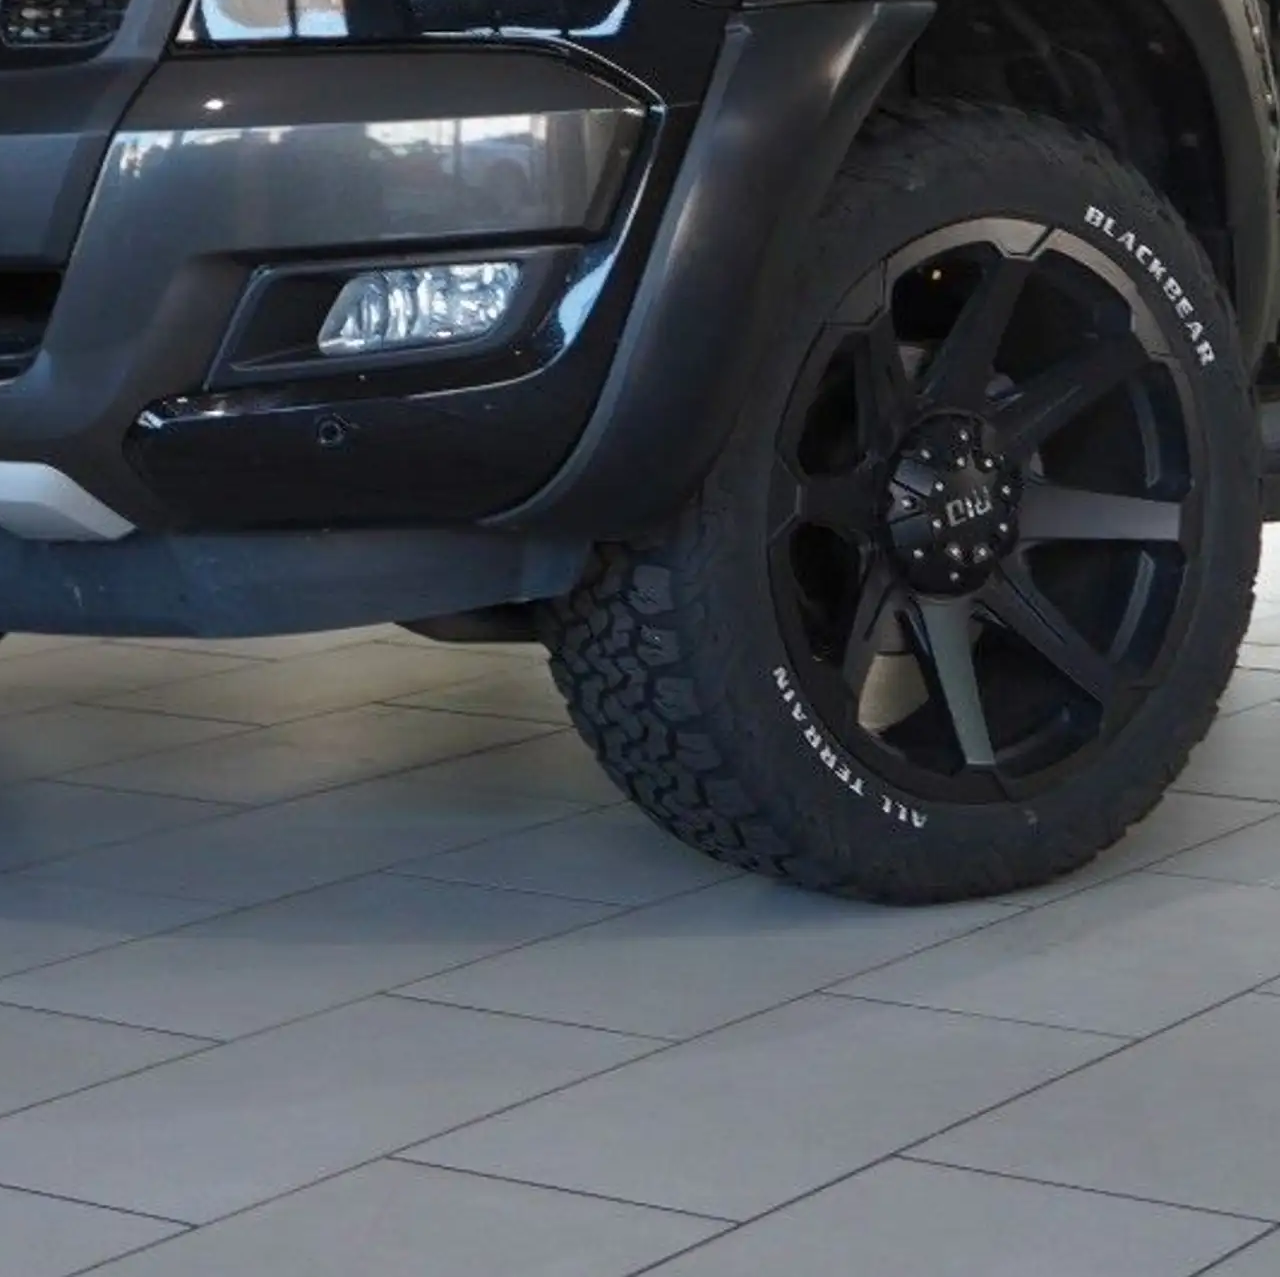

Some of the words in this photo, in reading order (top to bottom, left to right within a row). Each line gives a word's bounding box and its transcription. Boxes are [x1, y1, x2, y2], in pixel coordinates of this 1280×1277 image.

[1083, 204, 1216, 367] BLACKBEAR
[772, 666, 865, 797] TERRAIN
[880, 793, 928, 829] ALL
